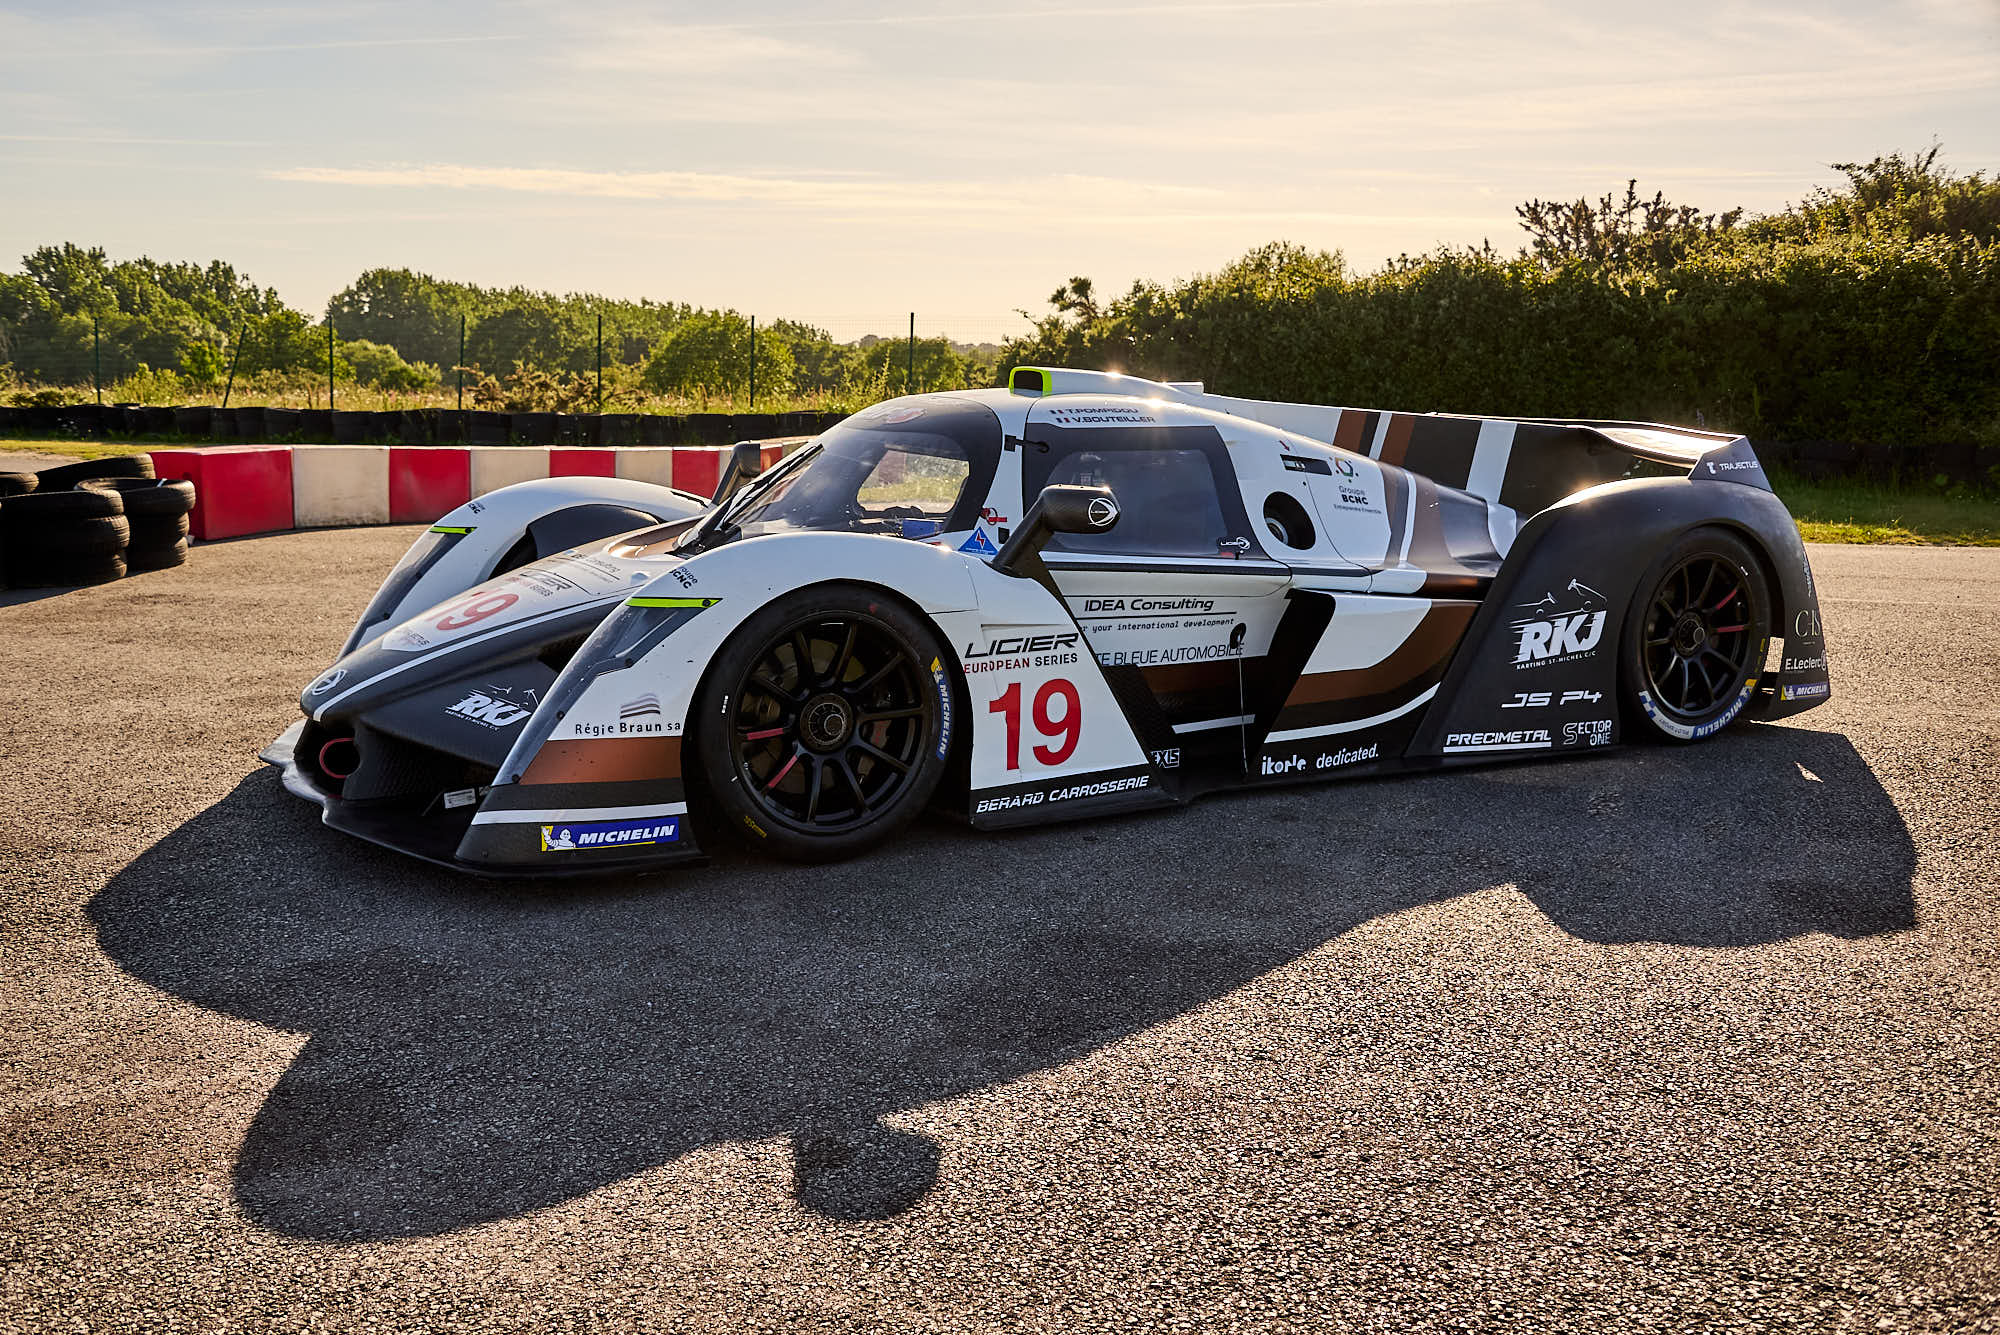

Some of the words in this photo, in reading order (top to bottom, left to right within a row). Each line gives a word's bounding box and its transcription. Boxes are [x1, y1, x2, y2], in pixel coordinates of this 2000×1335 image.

[1072, 415, 1157, 424] V.BOUTEILLER
[1719, 460, 1760, 471] TRAJECTUS
[1084, 599, 1126, 612] IDEA
[1130, 598, 1215, 612] Consulting
[1092, 623, 1113, 634] your
[1117, 620, 1179, 631] international
[1183, 617, 1235, 629] development
[964, 632, 1079, 659] LIGIER
[1512, 610, 1607, 664] RKJ
[963, 657, 1030, 674] EUROPEAN
[1034, 652, 1078, 667] SERIES
[1114, 650, 1158, 666] BLEUE
[1785, 657, 1822, 671] E.Leclerc
[1501, 691, 1552, 709] JS
[1559, 689, 1602, 706] P4
[1796, 684, 1828, 696] MICHELIN
[446, 690, 533, 727] RKJ
[1696, 698, 1743, 737] MICHELIN
[575, 723, 614, 737] Régie
[619, 722, 662, 733] Braun
[666, 722, 681, 731] sa
[939, 684, 951, 755] MICHELIN
[988, 678, 1082, 771] 19
[1446, 729, 1552, 746] PRECIMETAL
[1589, 732, 1612, 746] ONE
[1315, 742, 1380, 769] dedicated.
[1048, 775, 1150, 802] CARROSSERIE
[577, 824, 676, 845] MICHELIN
